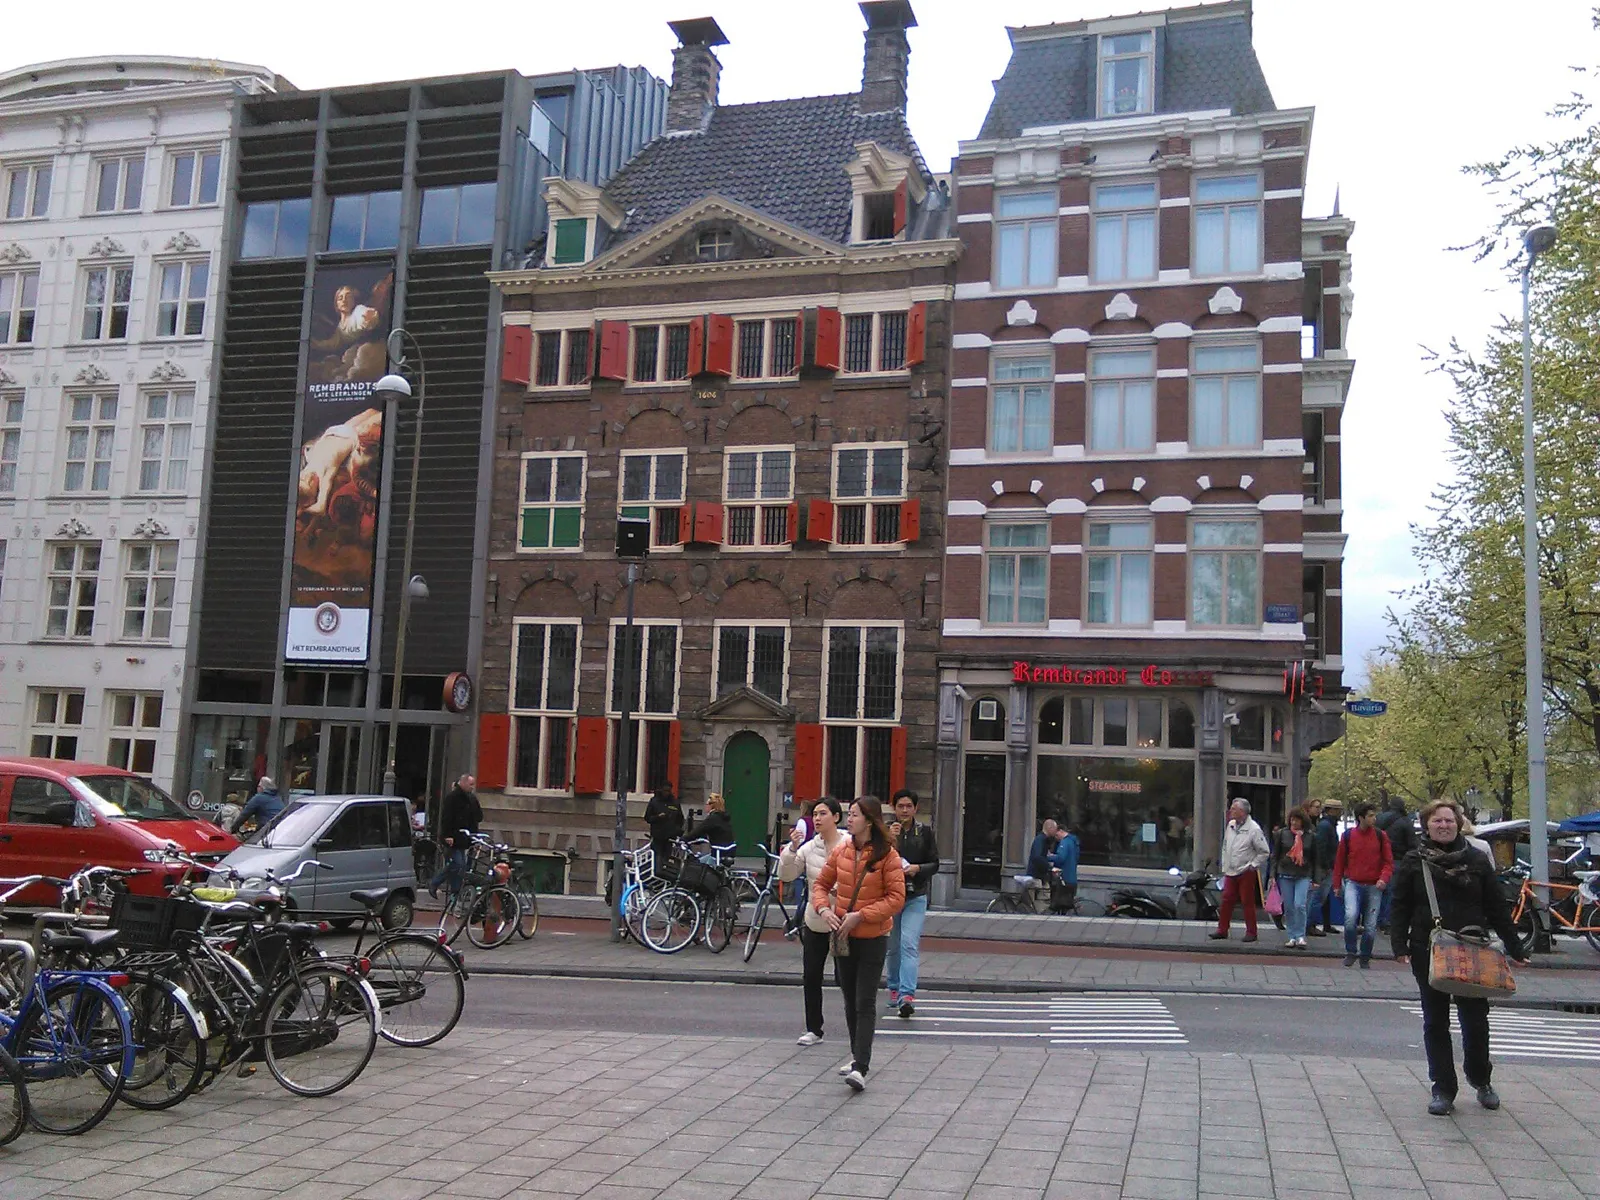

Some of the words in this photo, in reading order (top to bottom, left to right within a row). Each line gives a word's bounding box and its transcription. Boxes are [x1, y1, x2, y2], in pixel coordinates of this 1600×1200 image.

[309, 382, 378, 392] REMBRANDTS
[698, 391, 717, 399] 1606
[305, 645, 361, 653] REMBRANDTHUIS
[1012, 661, 1128, 685] Rembrandt
[1351, 703, 1383, 712] Bavaria
[1088, 781, 1142, 793] STEAKHOUSE
